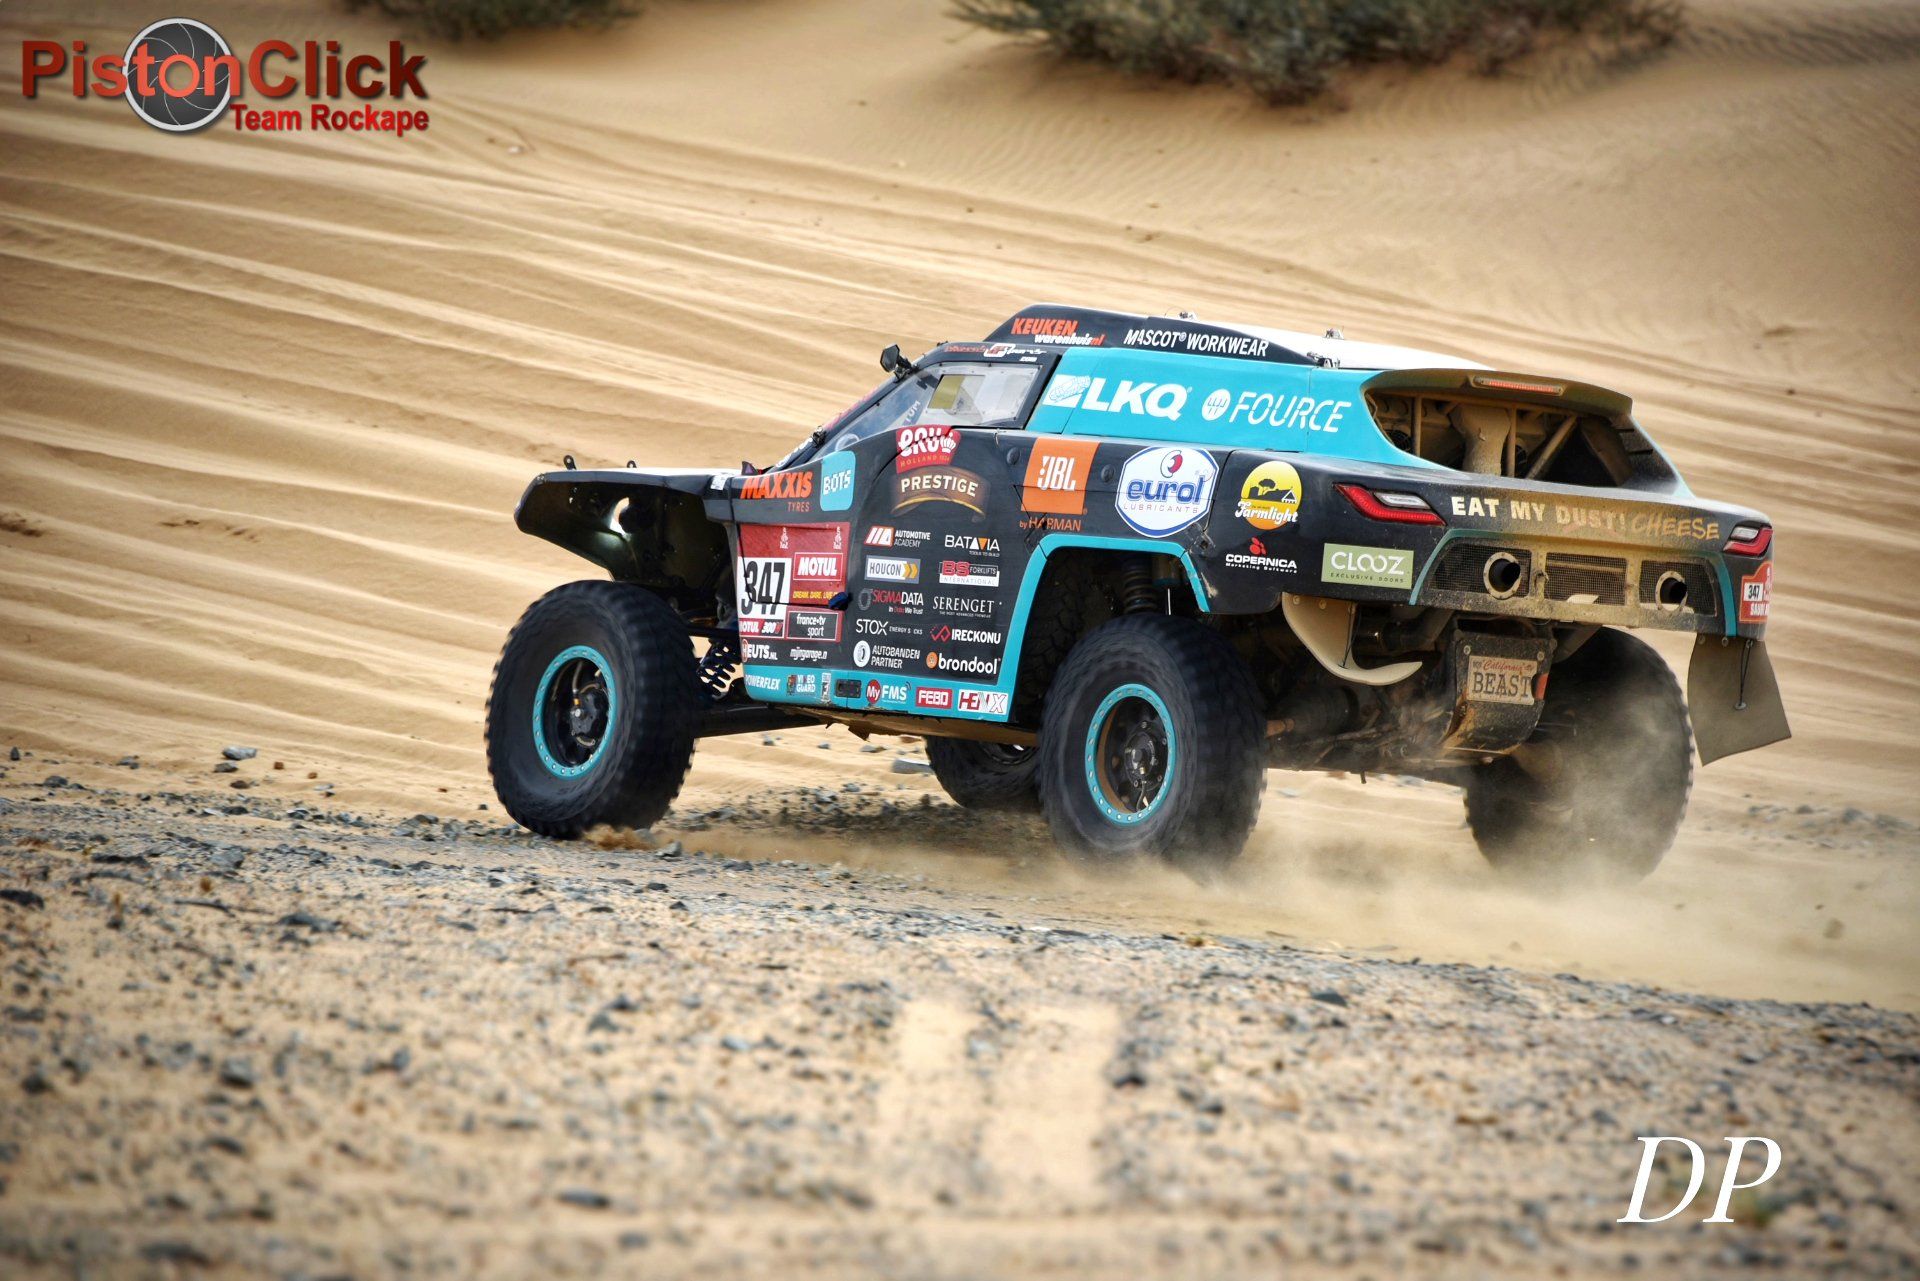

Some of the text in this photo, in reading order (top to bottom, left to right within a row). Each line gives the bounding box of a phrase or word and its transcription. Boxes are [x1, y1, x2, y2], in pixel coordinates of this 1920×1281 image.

[1011, 318, 1079, 336] KEUKEN
[1187, 333, 1269, 357] WORKWEAR
[1229, 391, 1352, 433] FOURCE
[1037, 456, 1077, 491] JBL
[740, 471, 813, 500] MAXXIS
[823, 470, 851, 495] BOTS
[901, 475, 978, 497] PRESTIGE
[1127, 475, 1207, 504] eurol
[787, 501, 810, 513] TYRES
[1123, 503, 1199, 514] LUBRICANTS
[1235, 501, 1299, 525] Farmlight
[1019, 520, 1028, 529] by
[1451, 496, 1500, 518] EAT
[1510, 500, 1545, 522] MY
[1631, 512, 1720, 541] CHEESE
[894, 539, 921, 548] ACADEMY
[895, 530, 931, 541] AUTOMOTIVE
[944, 535, 1000, 552] BATAVIA
[797, 557, 838, 576] MOTUL
[869, 562, 902, 576] HOUCON
[942, 560, 997, 577] BS FORKLIFTS
[1226, 554, 1297, 569] COPERNICA
[1226, 563, 1297, 574] Marketing Software
[1331, 551, 1405, 576] CLOOZ
[940, 577, 998, 586] INTERNATIONAL
[1331, 572, 1373, 581] EXCLUSIVE
[741, 561, 786, 615] 347
[1748, 584, 1760, 599] 347
[807, 625, 824, 638] sport
[856, 618, 888, 636] STOX
[907, 627, 923, 635] SCKS
[951, 628, 1001, 645] IRECKONU
[872, 645, 920, 660] AUTOBANDEN
[870, 656, 903, 669] PARTNER
[939, 652, 998, 675] brondool
[796, 684, 815, 693] GUARD
[1471, 672, 1532, 697] BEAST
